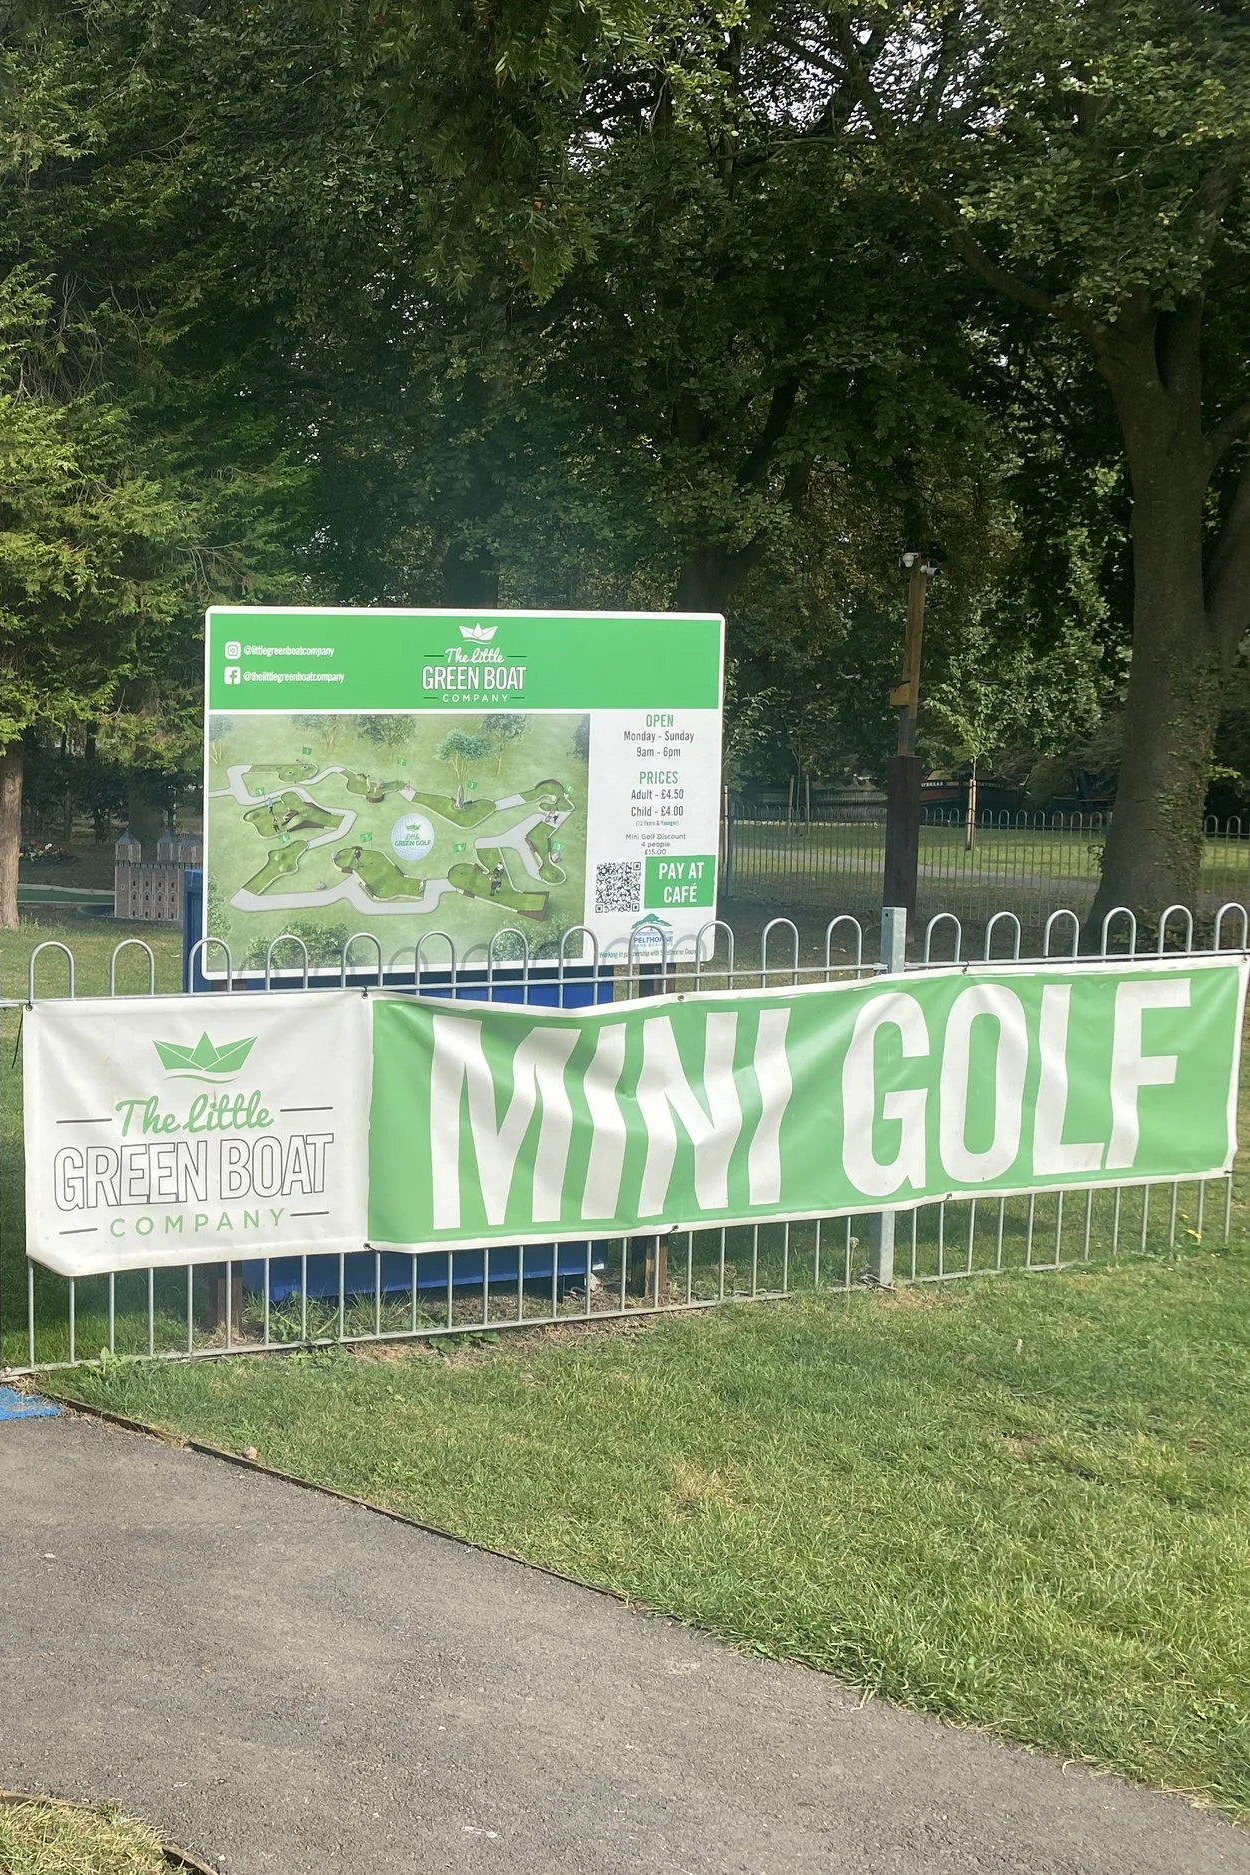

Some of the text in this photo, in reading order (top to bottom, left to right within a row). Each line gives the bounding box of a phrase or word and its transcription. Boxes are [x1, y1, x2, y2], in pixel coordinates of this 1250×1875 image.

[243, 645, 334, 657] @littlegreenboatcompany
[445, 647, 505, 663] The Little
[243, 671, 345, 683] @thelittlegreenboatcompany
[422, 665, 526, 690] GREEN BOAT
[442, 693, 508, 702] COMPANY
[646, 714, 674, 727] OPEN
[624, 730, 656, 743] Monday
[664, 730, 694, 743] Sunday
[636, 746, 654, 757] 9am
[663, 746, 681, 759] 6pm
[639, 771, 679, 784] PRICES
[631, 789, 653, 800] Adult
[661, 788, 684, 800] £4.50
[631, 806, 652, 817] Child
[661, 805, 684, 817] £4.00
[658, 862, 705, 880] PAY AT
[663, 882, 697, 903] CAFÉ
[431, 978, 1191, 1230] MINI GOLF
[115, 1089, 274, 1137] The Little
[54, 1133, 334, 1211] GREEN BOAT
[110, 1208, 286, 1238] COMPANY
